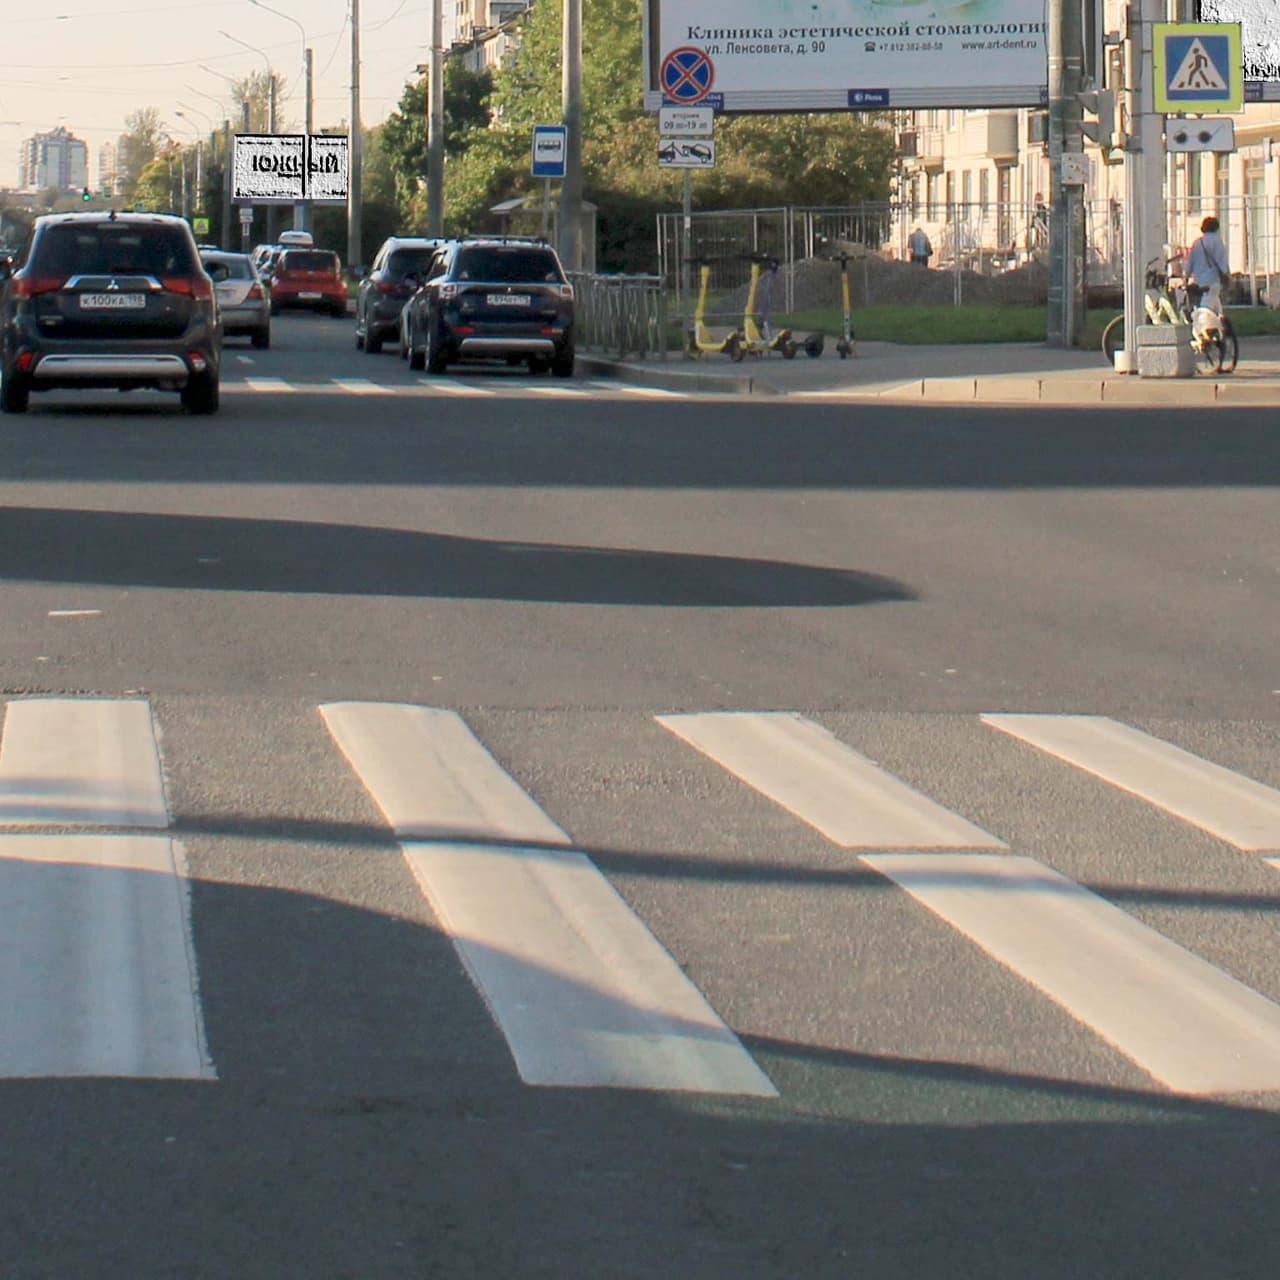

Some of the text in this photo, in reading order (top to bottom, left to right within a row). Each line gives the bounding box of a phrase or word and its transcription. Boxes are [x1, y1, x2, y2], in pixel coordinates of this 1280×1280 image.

[687, 25, 773, 39] Клиника
[778, 21, 909, 39] эстетической
[726, 42, 793, 55] Ленсовета,
[812, 41, 826, 53] 90
[961, 39, 1037, 51] www.art-dent.ru
